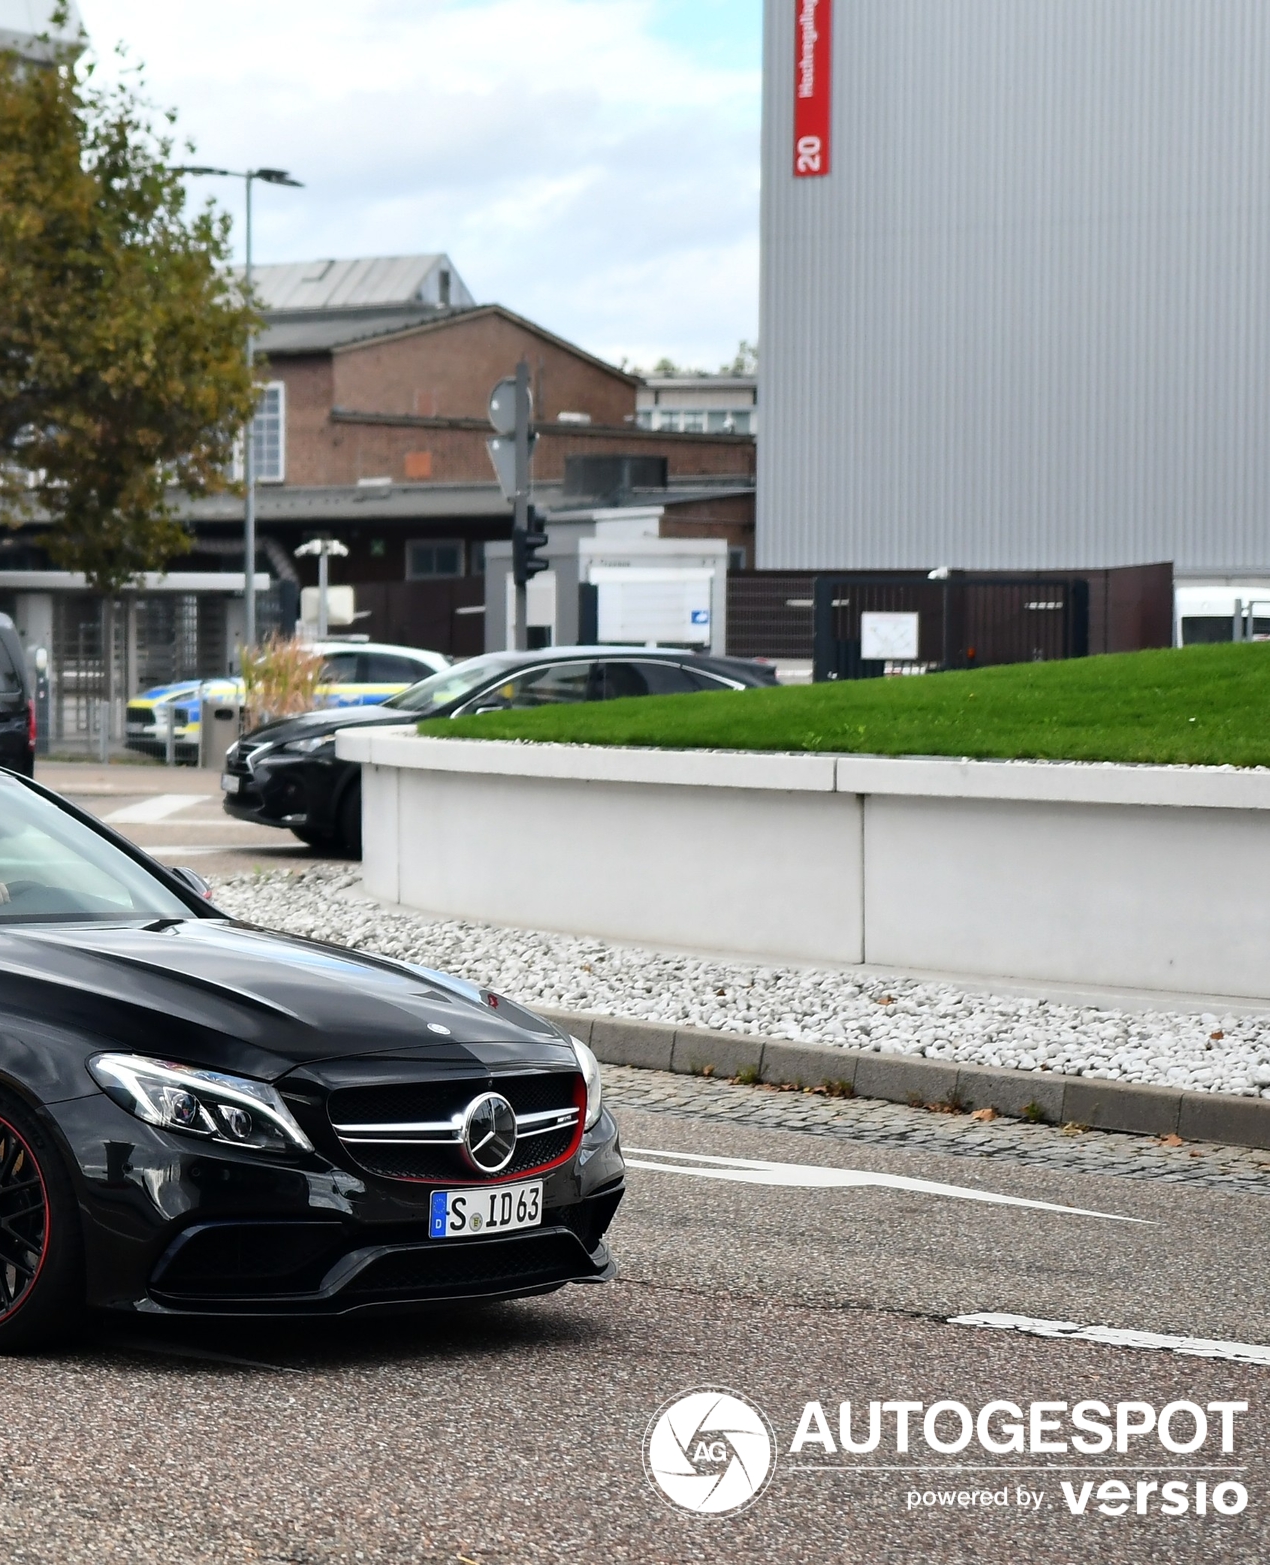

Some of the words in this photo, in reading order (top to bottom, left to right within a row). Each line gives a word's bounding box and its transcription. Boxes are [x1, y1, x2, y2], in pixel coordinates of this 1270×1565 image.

[797, 135, 821, 173] 20
[435, 1219, 442, 1229] D
[449, 1196, 467, 1231] S
